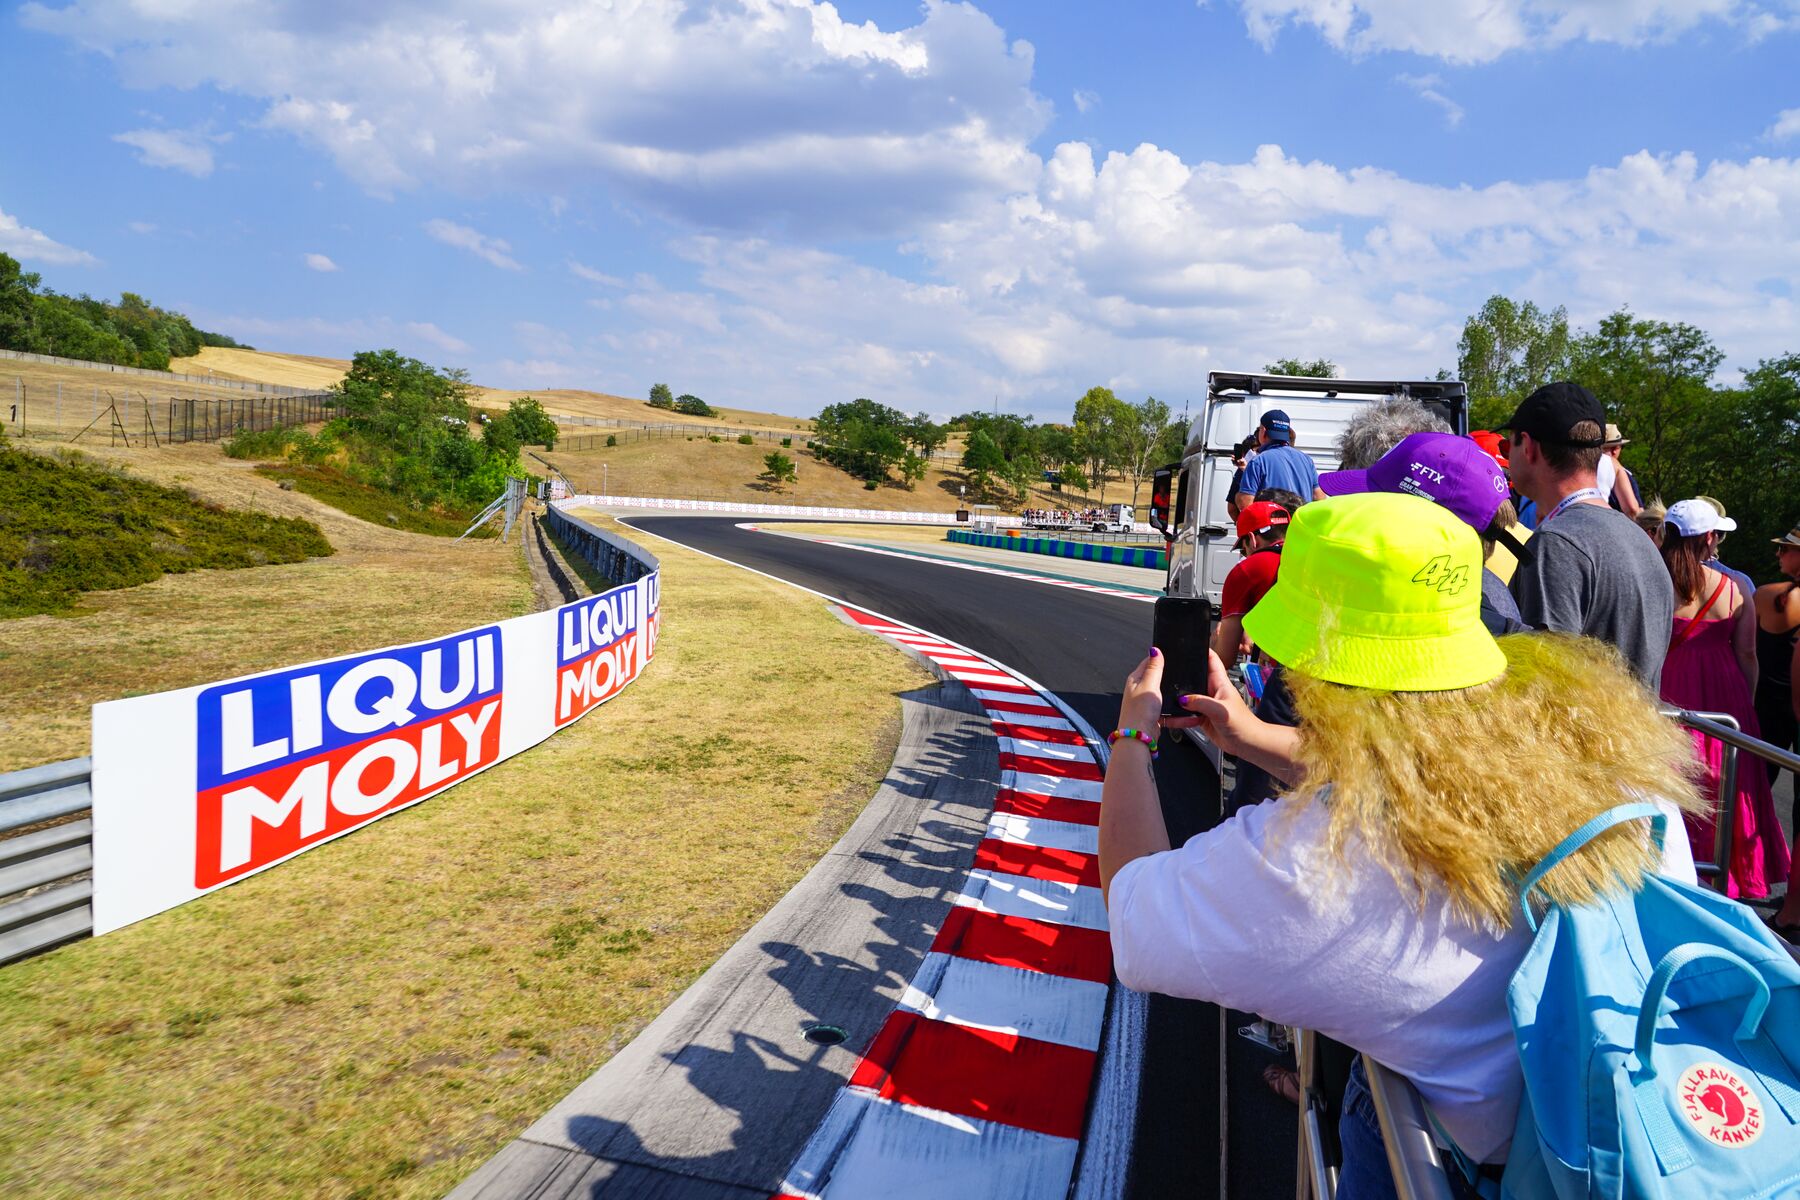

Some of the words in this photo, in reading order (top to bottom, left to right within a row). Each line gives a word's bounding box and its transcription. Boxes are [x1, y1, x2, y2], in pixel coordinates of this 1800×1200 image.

[1399, 480, 1414, 490] GRAN
[1419, 466, 1445, 485] FTX
[1411, 554, 1469, 596] 44
[562, 589, 636, 661] LIQUI
[220, 633, 495, 776] LIQUI
[560, 635, 637, 720] MOLY
[219, 700, 500, 874] MOLY
